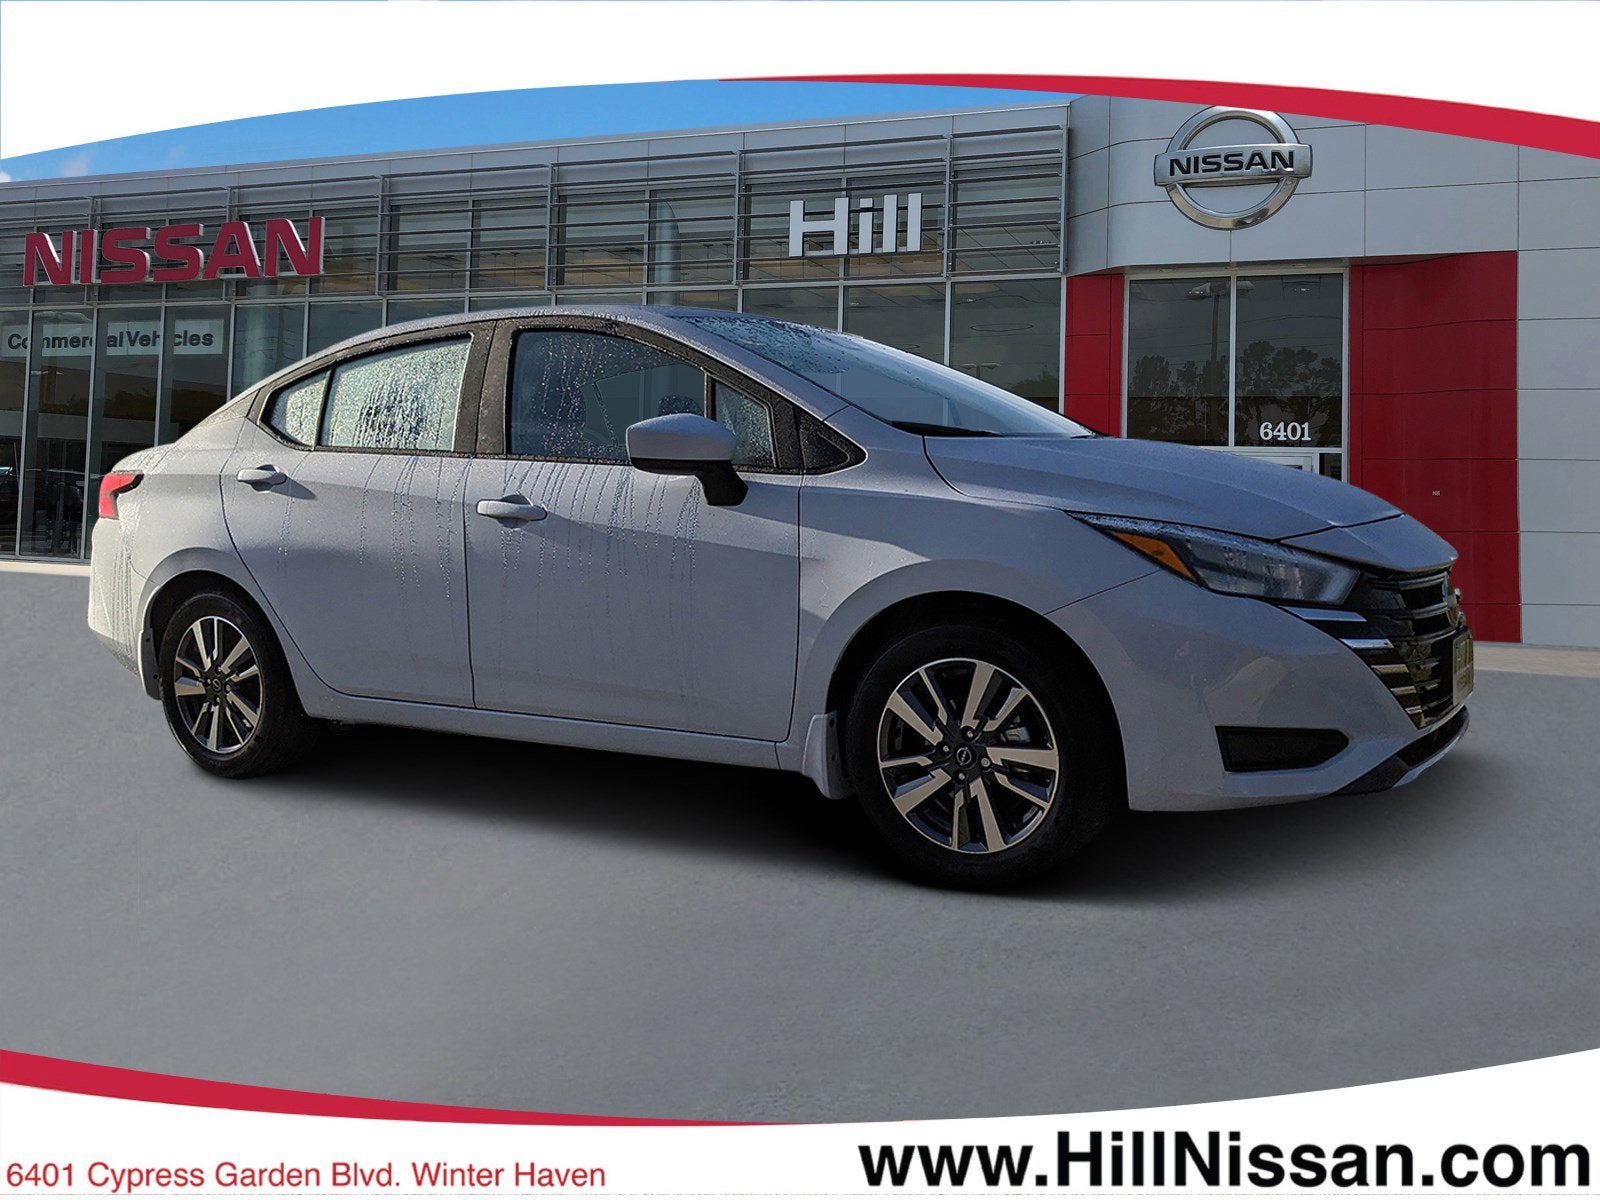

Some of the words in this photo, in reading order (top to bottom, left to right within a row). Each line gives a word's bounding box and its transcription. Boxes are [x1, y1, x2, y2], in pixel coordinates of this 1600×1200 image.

[1169, 150, 1295, 177] NISSAN
[788, 193, 922, 257] Hill
[23, 216, 325, 287] NISSAN
[7, 331, 123, 350] Commeral
[126, 330, 214, 347] Vehcles
[1259, 421, 1312, 441] 6401
